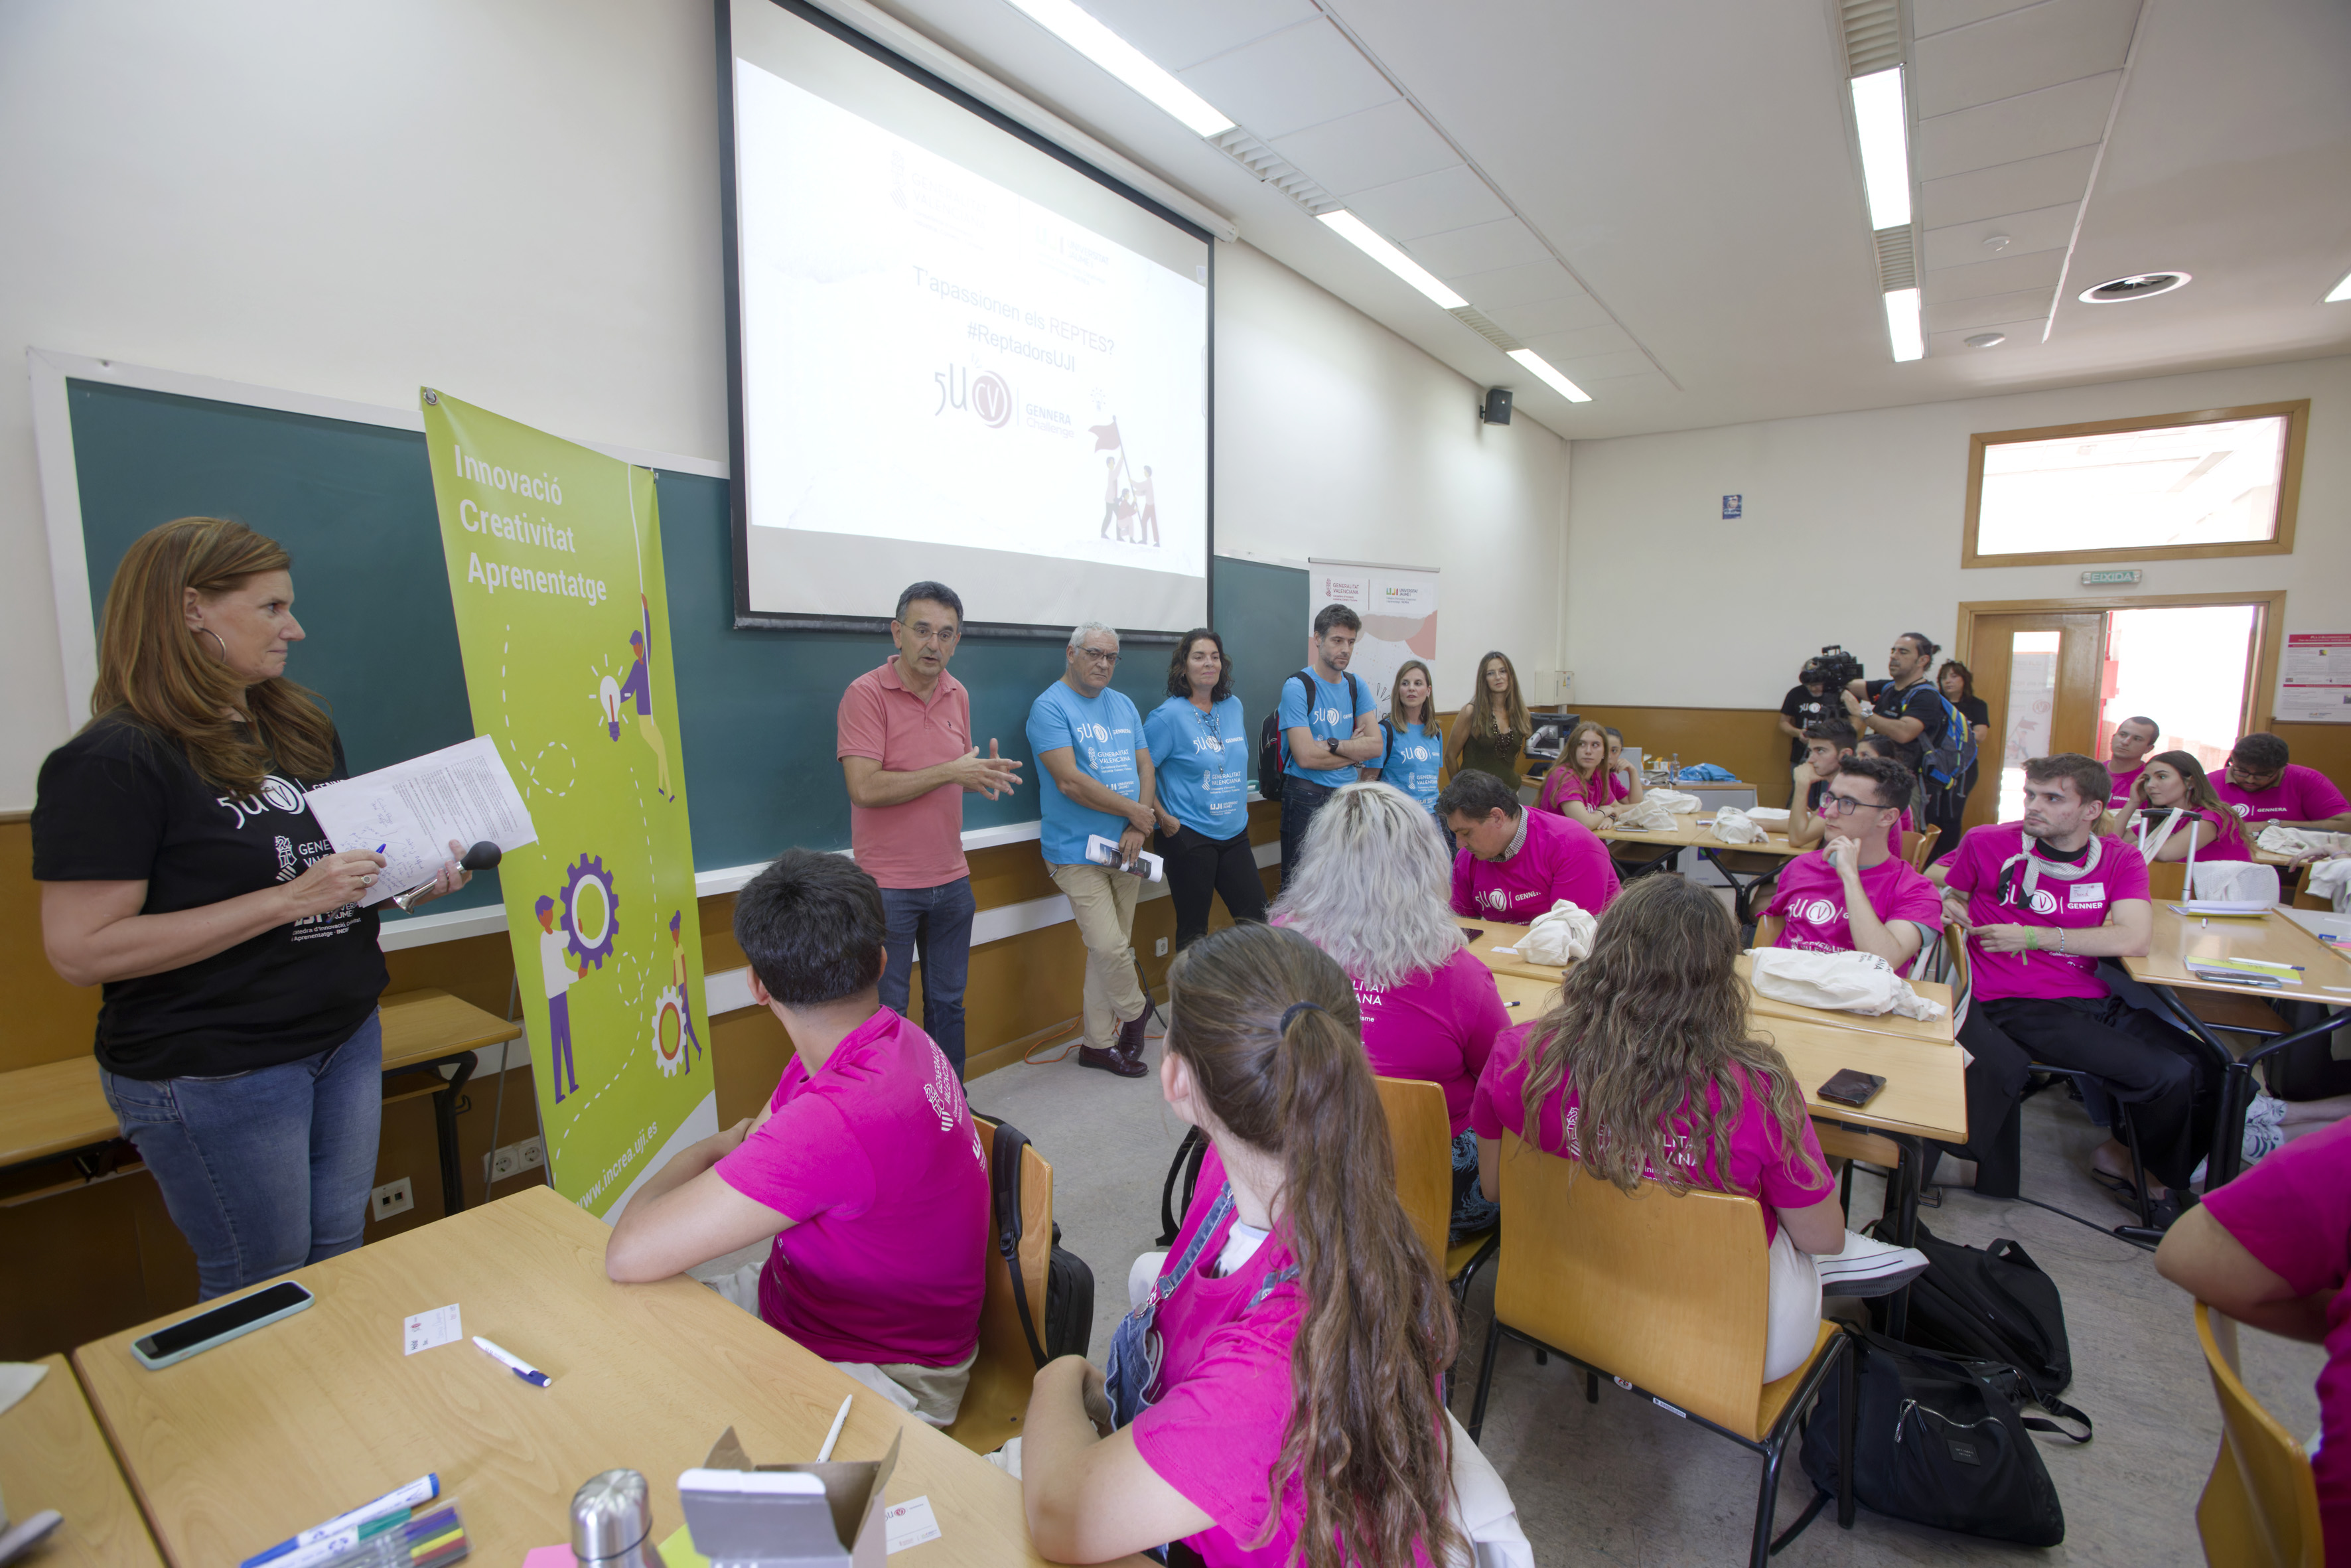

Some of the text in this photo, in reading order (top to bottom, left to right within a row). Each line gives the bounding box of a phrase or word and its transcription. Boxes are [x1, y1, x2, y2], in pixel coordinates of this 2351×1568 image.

[911, 173, 987, 216] GENERALITAT
[912, 188, 986, 230] VALENCIANA
[1066, 238, 1109, 265] UNIVERSITAT
[912, 265, 1020, 321] T'apassionen
[1025, 310, 1045, 330] els
[1049, 317, 1115, 358] REPTES?
[967, 321, 1074, 372] #ReptadorsUJI
[1025, 403, 1072, 426] GENNERA
[1026, 417, 1074, 439] Challenge
[454, 445, 563, 506] Innovació
[459, 498, 577, 553] Creativitat
[467, 552, 607, 606] Aprenentatge
[2092, 573, 2133, 581] EIXIDA
[1386, 587, 1398, 596] UJI
[1098, 749, 1129, 758] GENERALITAT
[1212, 771, 1241, 780] GENERALITAT
[294, 930, 333, 942] Aprenentatge
